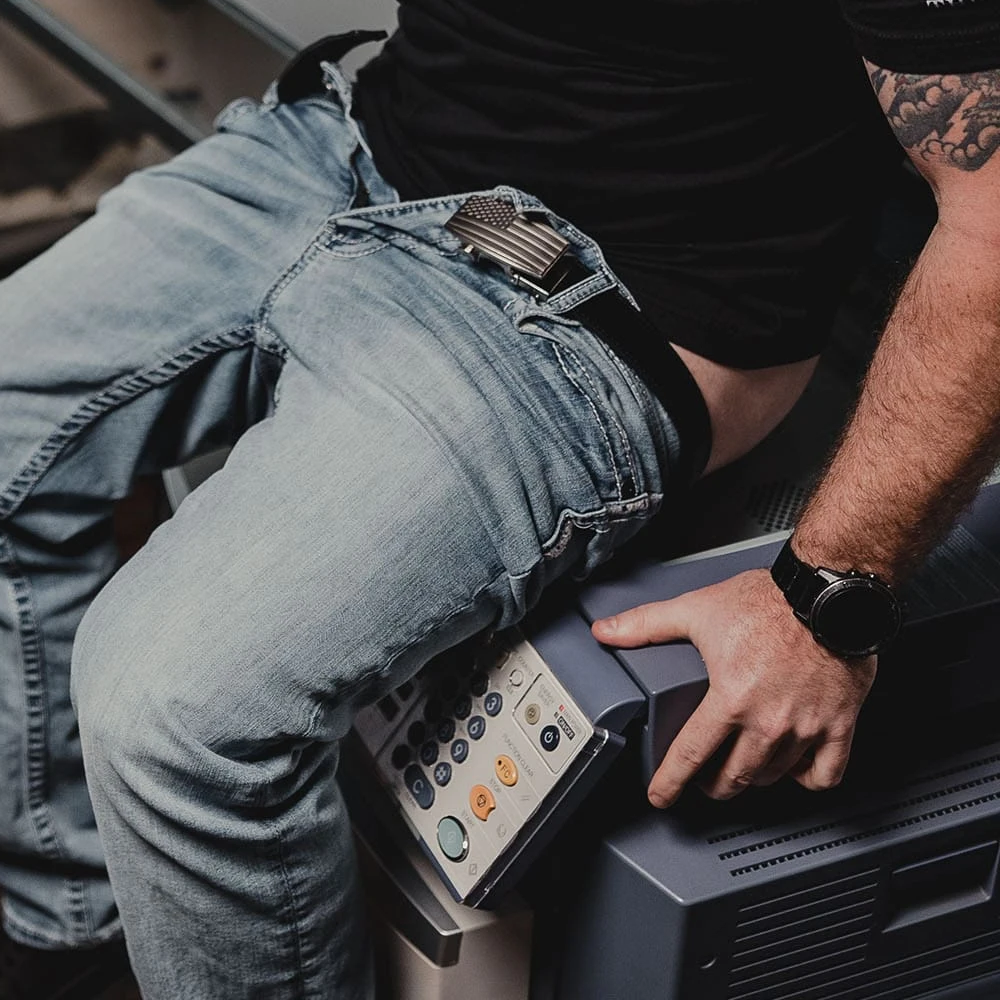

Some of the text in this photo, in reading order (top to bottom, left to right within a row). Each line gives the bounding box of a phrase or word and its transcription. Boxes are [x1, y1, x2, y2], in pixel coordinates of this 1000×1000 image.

[487, 696, 498, 710] 3
[470, 720, 480, 733] 6
[452, 744, 463, 757] 9
[412, 779, 424, 795] C
